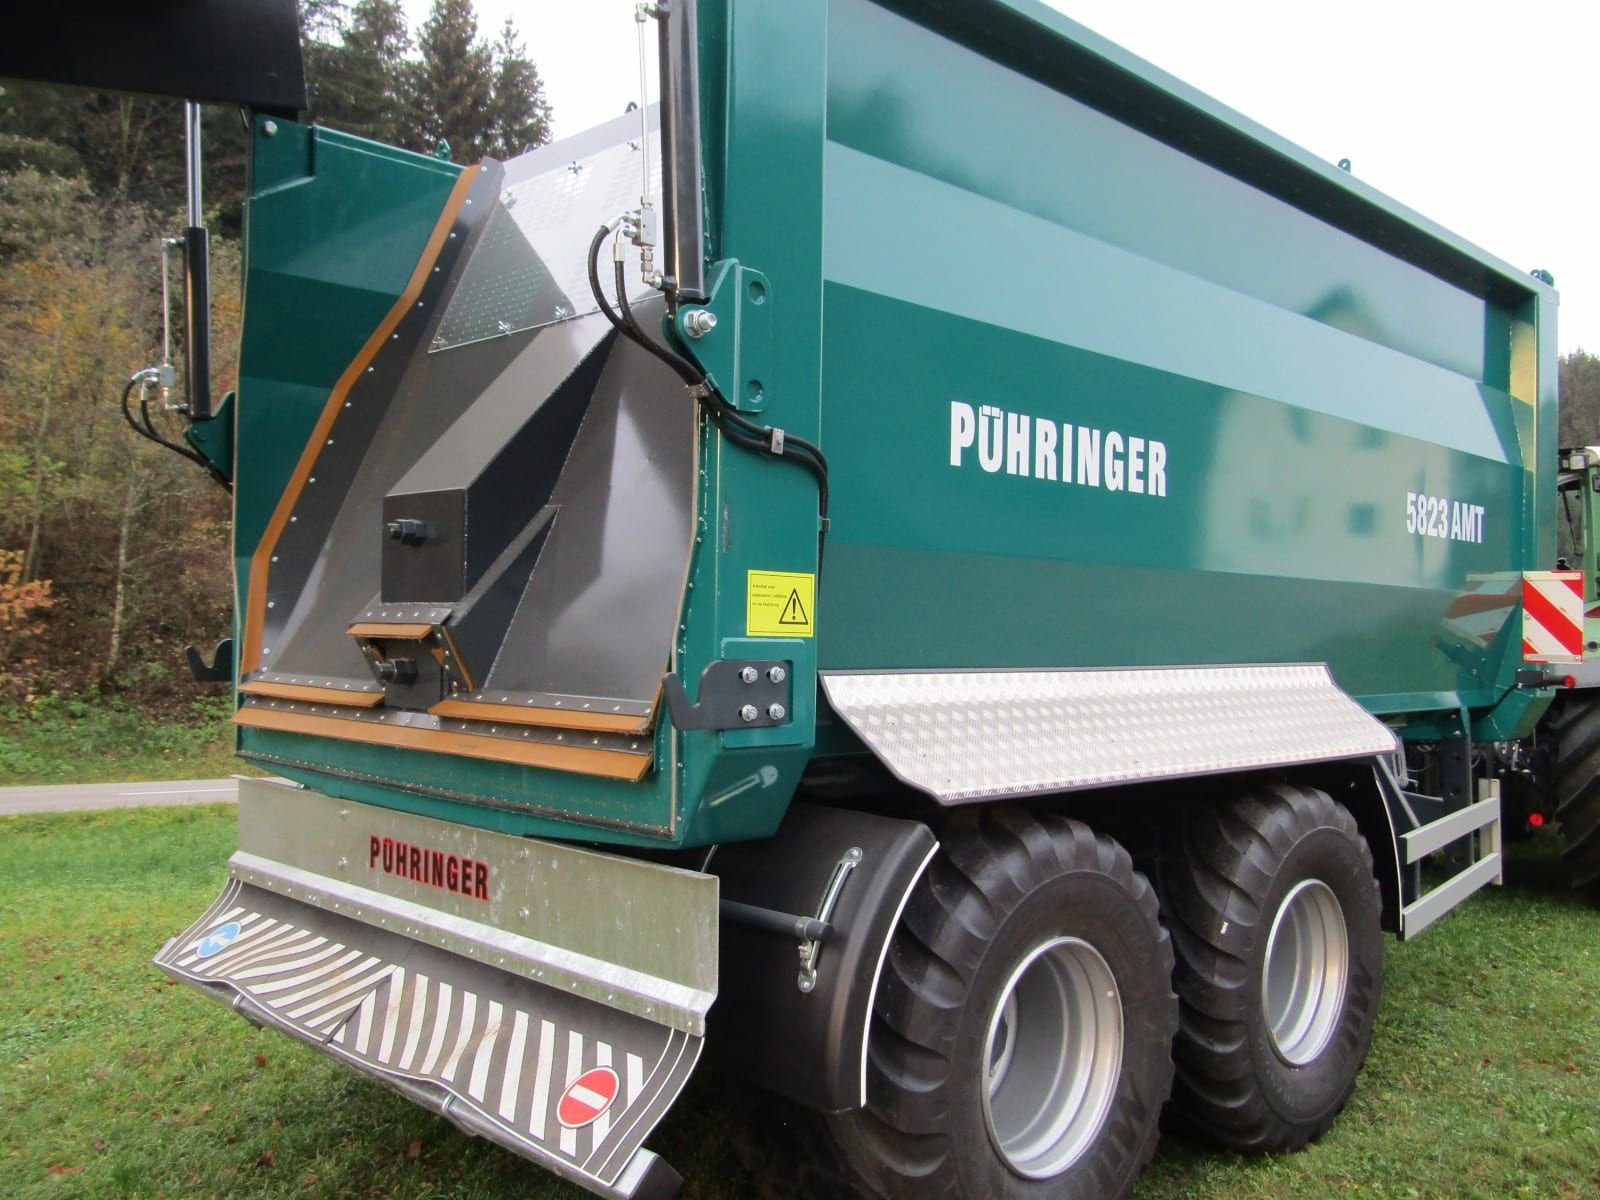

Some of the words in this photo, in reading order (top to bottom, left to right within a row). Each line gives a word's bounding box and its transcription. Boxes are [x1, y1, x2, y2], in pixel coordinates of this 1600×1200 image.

[950, 400, 1167, 497] PÜHRINGER
[1406, 492, 1448, 539] 5823
[1450, 501, 1485, 544] AMT
[369, 834, 490, 902] PÜHRINGER
